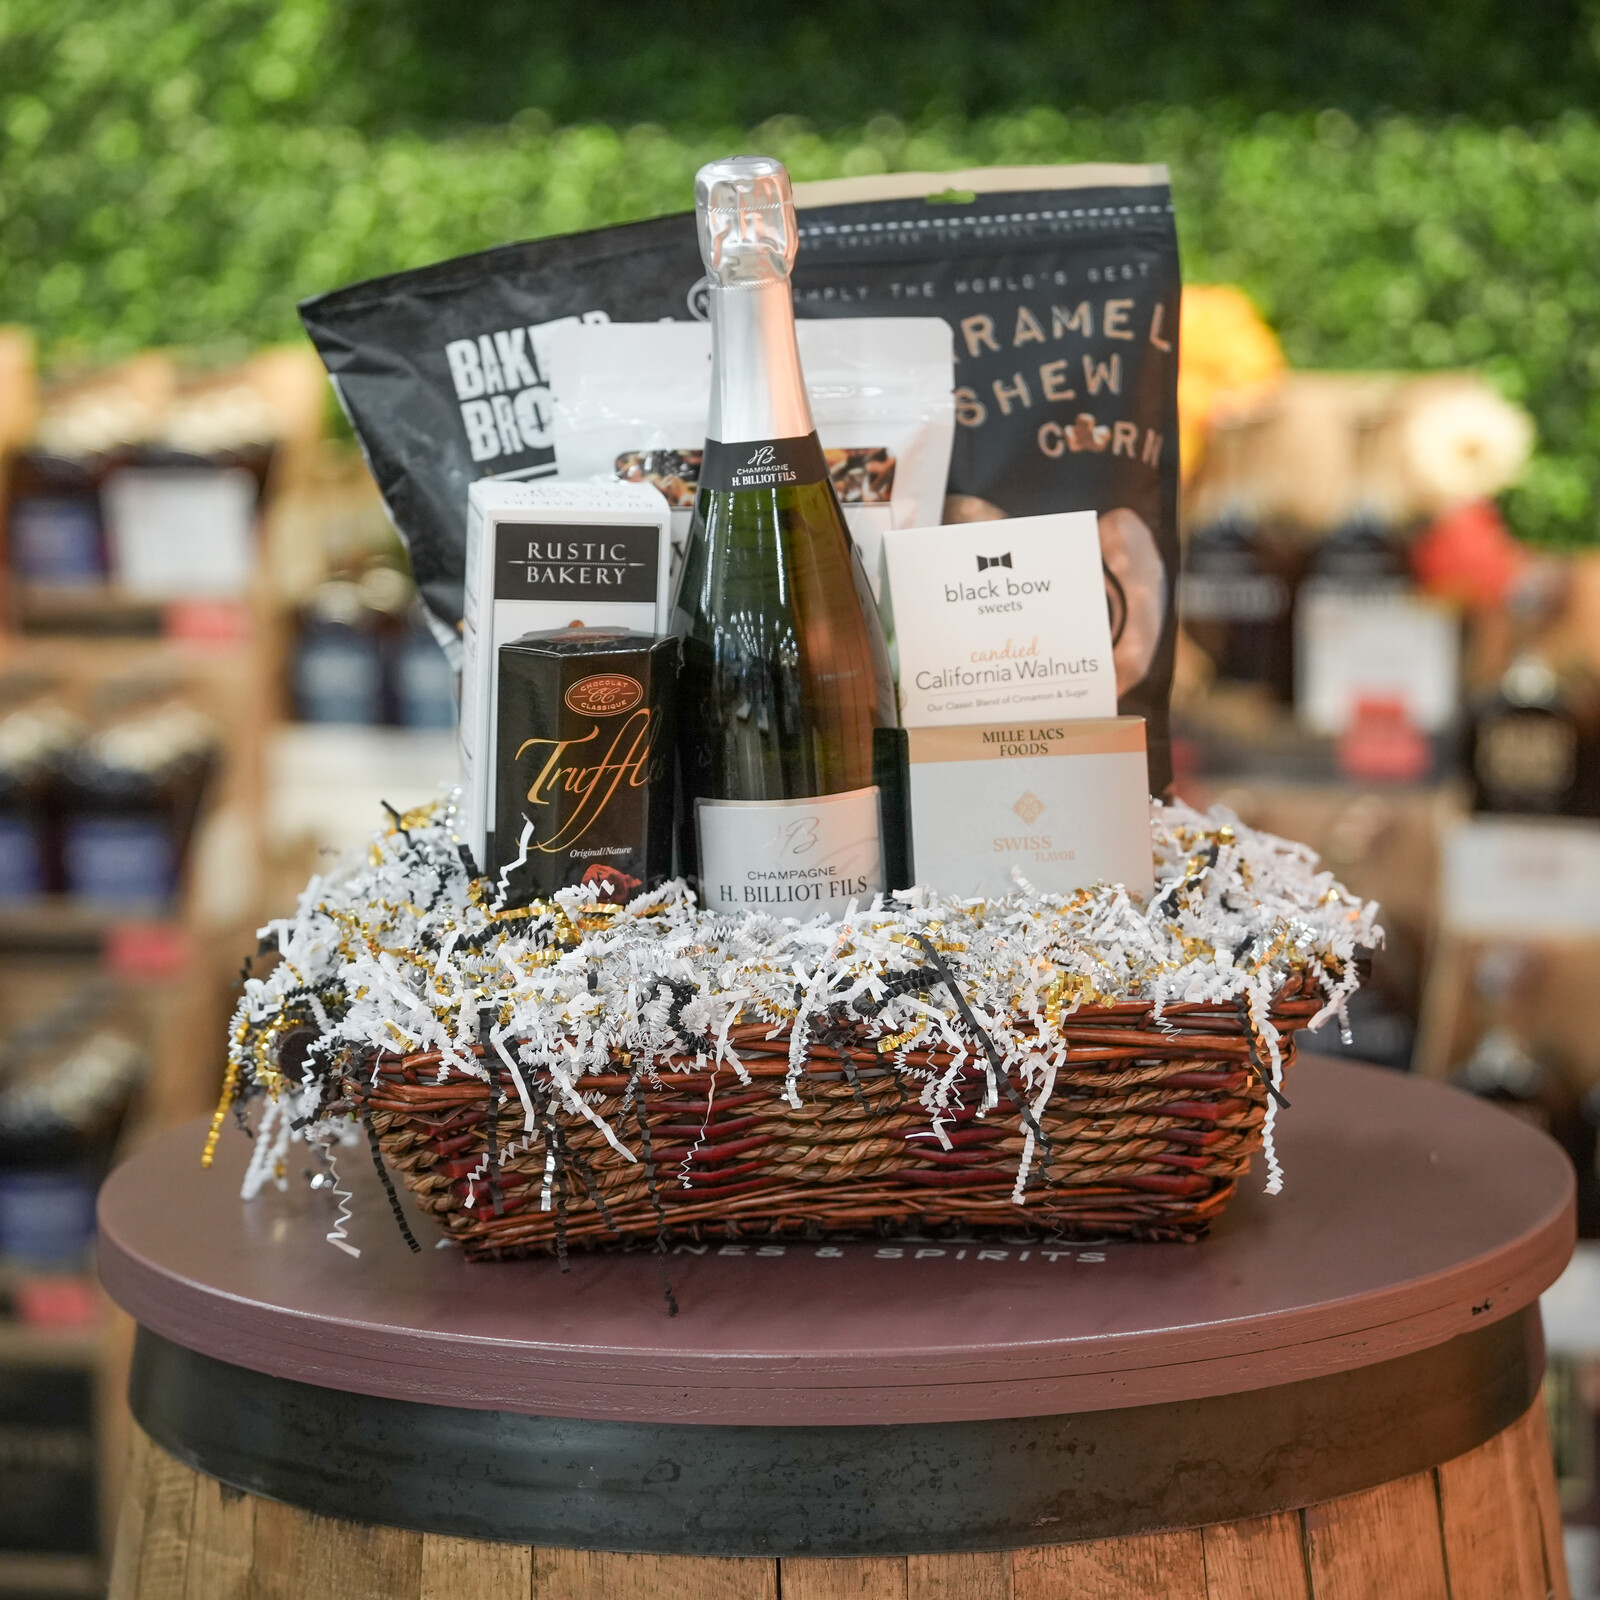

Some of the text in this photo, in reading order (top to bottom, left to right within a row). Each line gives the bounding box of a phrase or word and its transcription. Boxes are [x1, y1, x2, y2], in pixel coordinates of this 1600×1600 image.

[953, 299, 1172, 363] RAMEL
[737, 463, 789, 476] CHAMPAGNE
[742, 473, 777, 486] BILLIOT
[777, 471, 797, 482] FILS
[527, 541, 627, 561] RUSTIC
[526, 566, 627, 585] BAKERY
[944, 577, 1051, 602] black bow
[977, 600, 1023, 615] sweets
[970, 635, 1040, 663] candied
[915, 657, 1099, 690] California Walnuts
[580, 680, 628, 692] CHOCOLAT
[580, 699, 627, 711] CLASSIQUE
[926, 688, 1089, 712] Our Classic Blend of Cinnamon & Sugar
[982, 727, 1065, 744] MILLE LACS
[999, 742, 1049, 757] FOODS
[993, 835, 1053, 852] SWISS
[569, 846, 632, 859] Original/Nature
[1035, 850, 1076, 863] FLAVOR
[747, 865, 837, 880] CHAMPAGNE
[720, 875, 868, 903] H. BILLIOT FILS
[645, 1243, 1107, 1263] NES & SPIRITS
